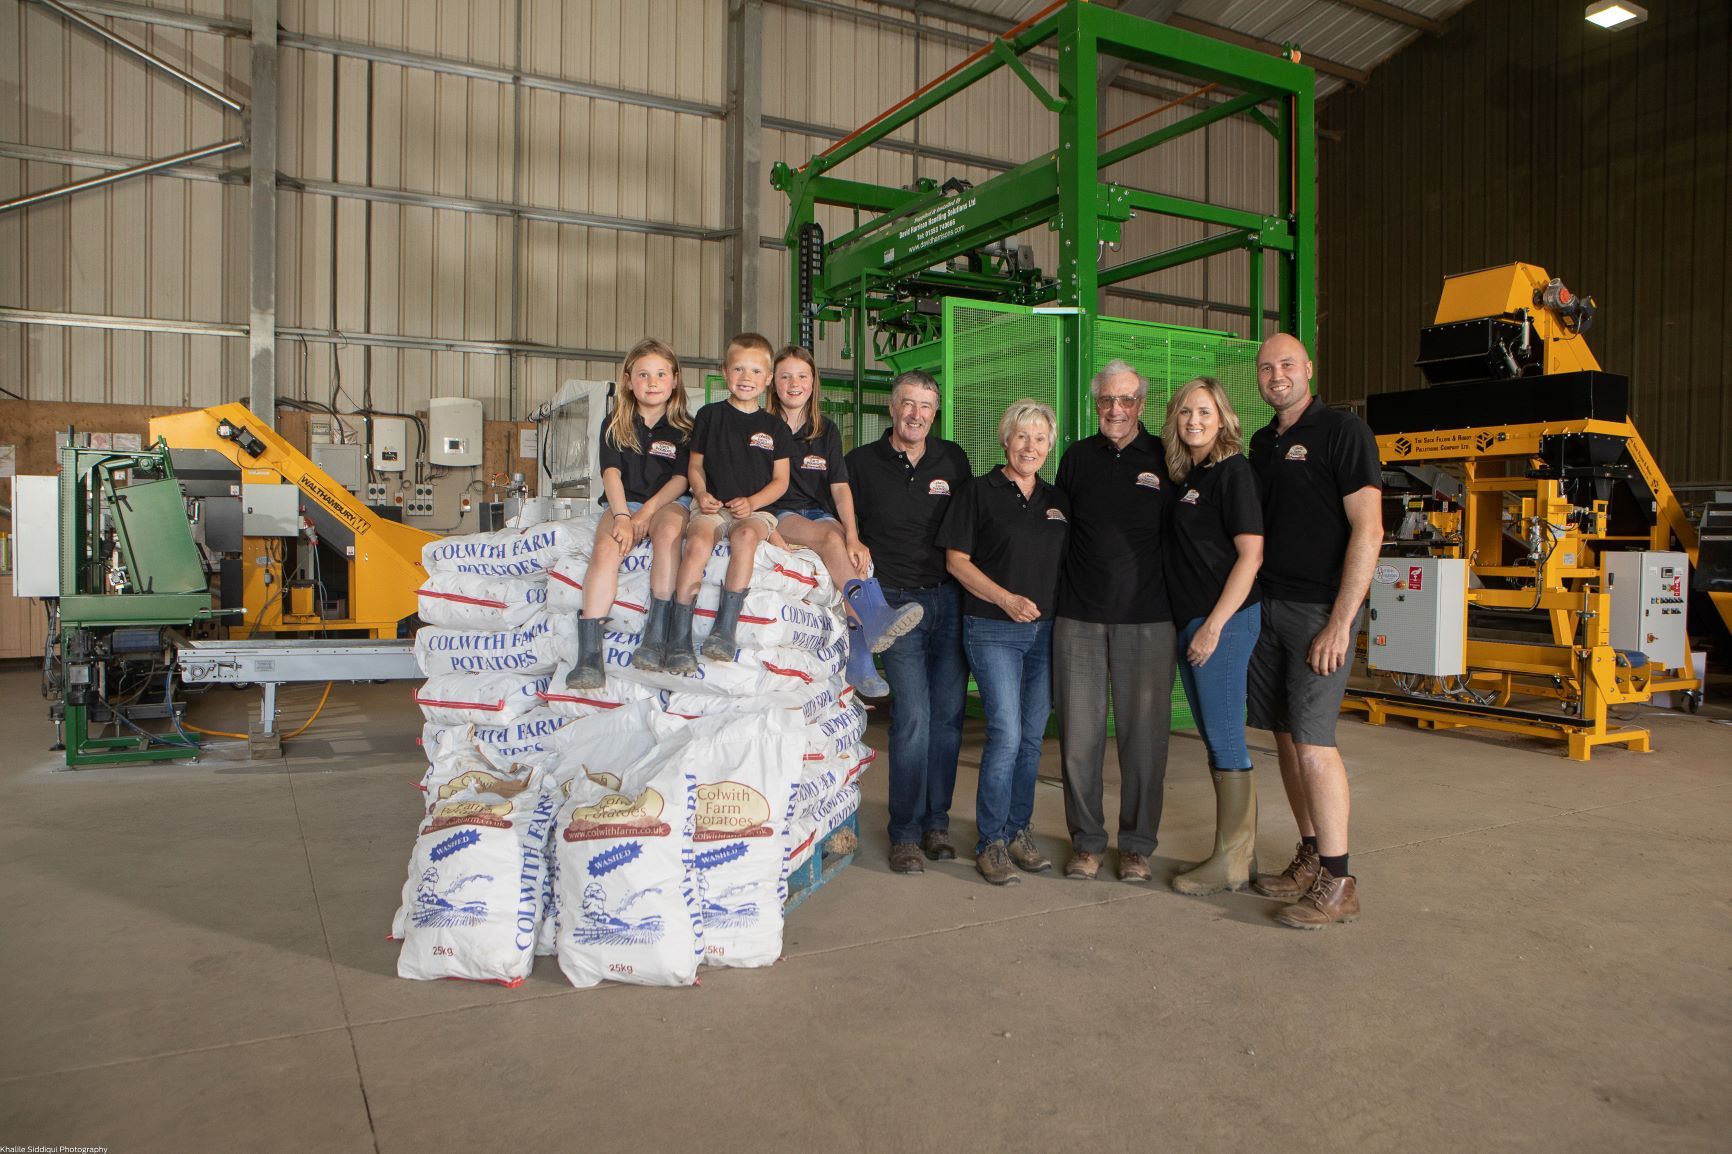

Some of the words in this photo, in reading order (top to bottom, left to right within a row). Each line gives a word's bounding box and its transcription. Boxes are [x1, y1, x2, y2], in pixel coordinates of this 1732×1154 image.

[301, 476, 356, 521] WALTHAMBURY
[433, 543, 506, 561] COLWITH
[512, 530, 556, 557] FARM
[428, 633, 505, 652] COLWITH
[450, 650, 538, 671] POTATOES
[517, 717, 563, 741] FARM
[697, 788, 750, 802] Colwith
[706, 802, 741, 814] Farm
[695, 813, 753, 827] Potatoes
[569, 825, 664, 839] www.colwithfarm.co.uk
[436, 836, 470, 855] WASHED
[595, 849, 631, 870] WASHED
[701, 848, 738, 864] WASHED
[515, 844, 539, 951] COLWITH
[433, 946, 453, 957] 25kg
[608, 964, 633, 974] 25kg
